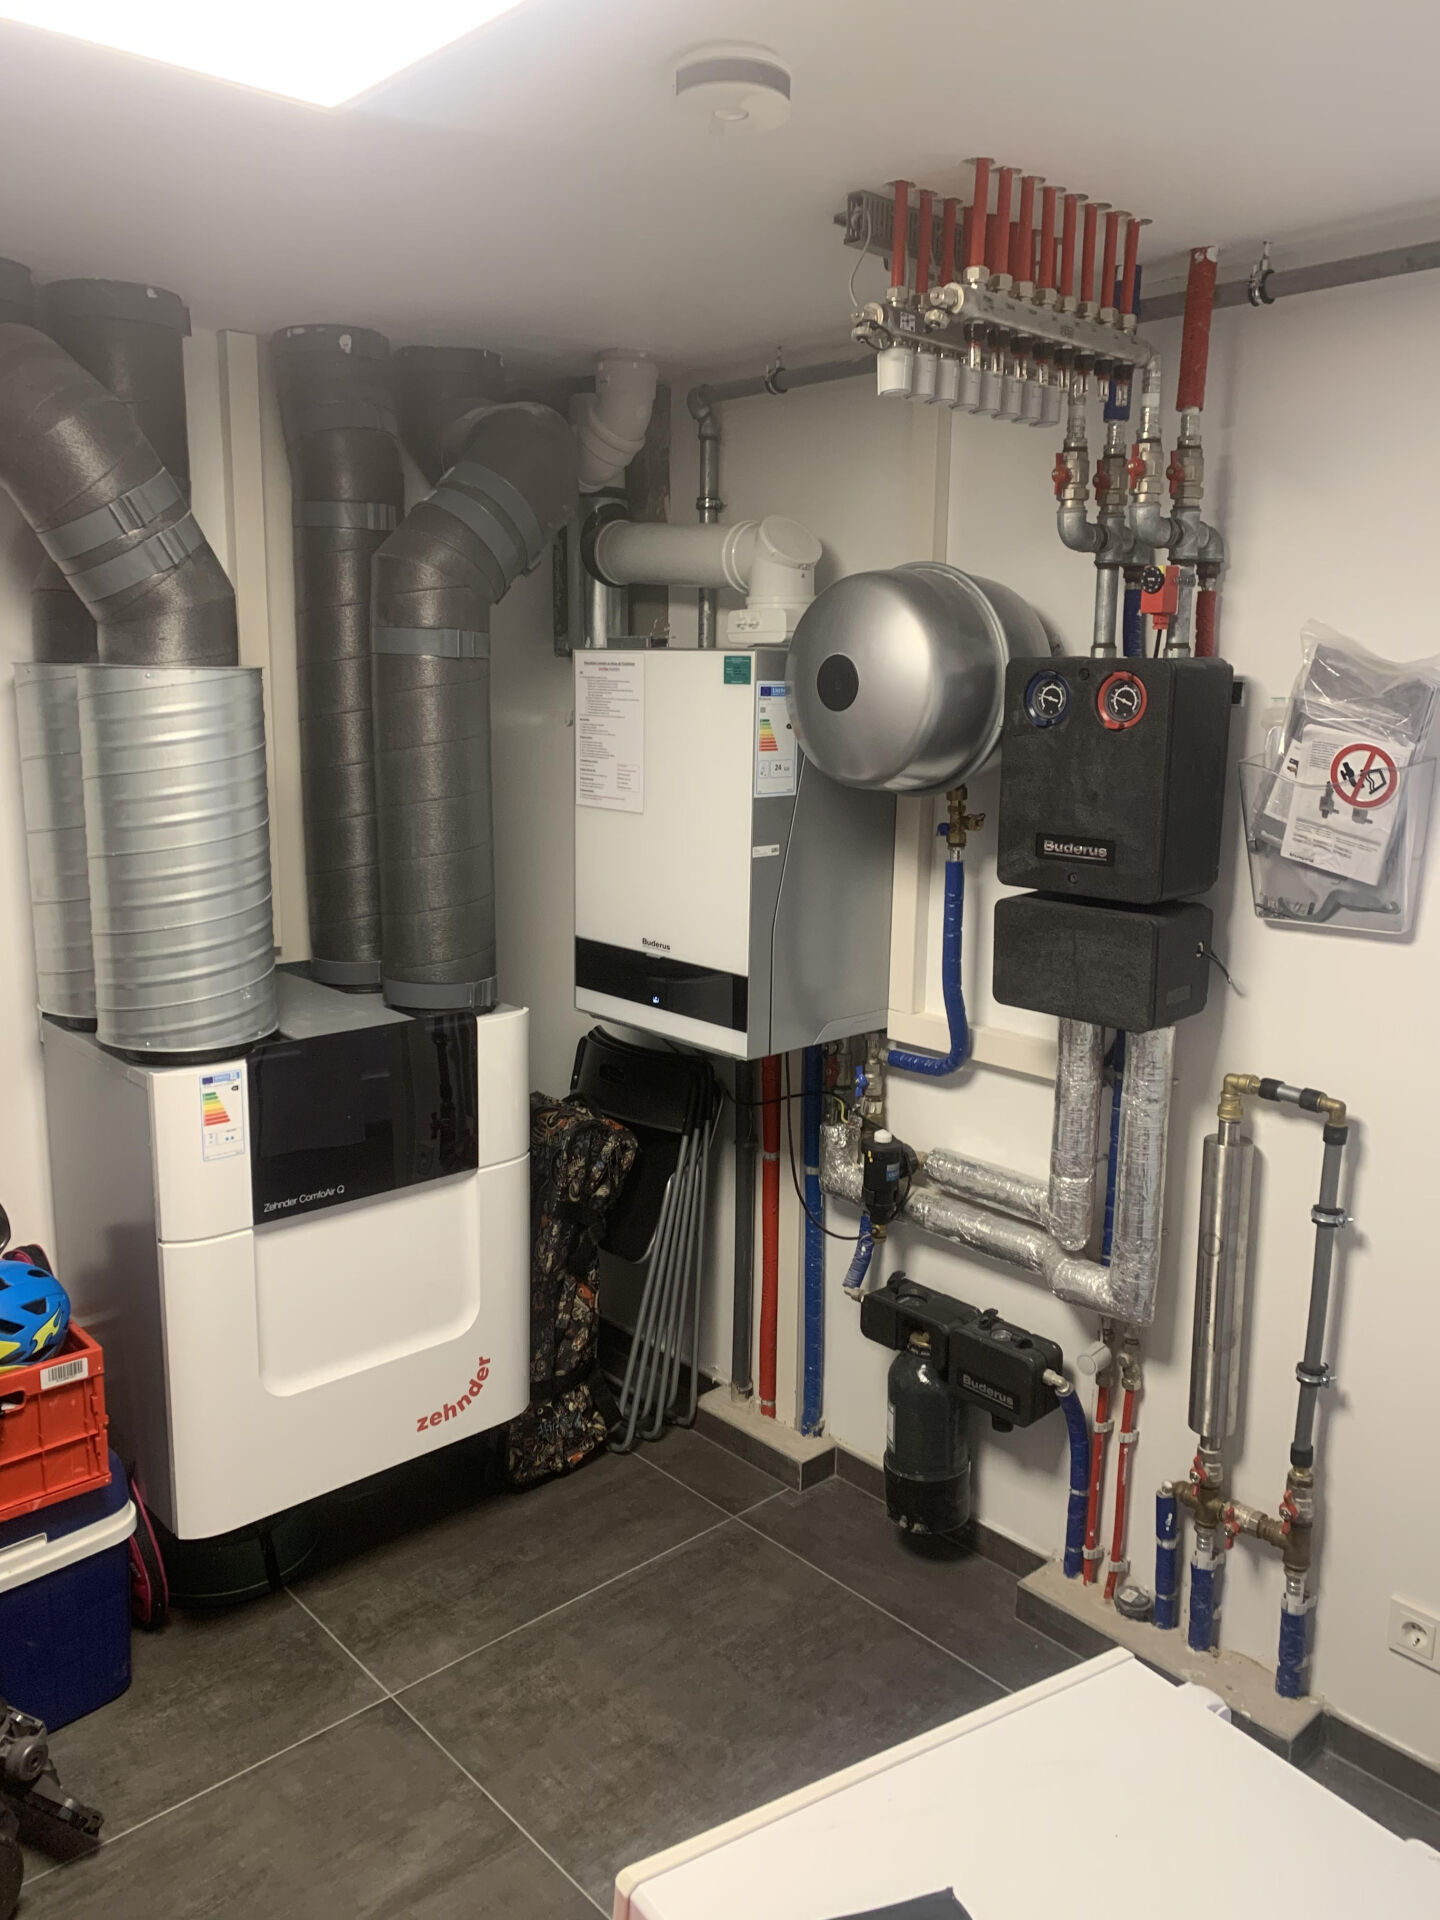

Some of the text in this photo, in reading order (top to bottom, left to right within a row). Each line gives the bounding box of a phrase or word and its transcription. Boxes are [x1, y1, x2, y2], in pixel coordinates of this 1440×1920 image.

[1043, 839, 1107, 858] Buderus
[642, 937, 671, 951] Buderus
[263, 1184, 345, 1213] Zehnder ComfoAir Q
[416, 1355, 491, 1433] zehnder
[962, 1373, 1014, 1406] Buderus
